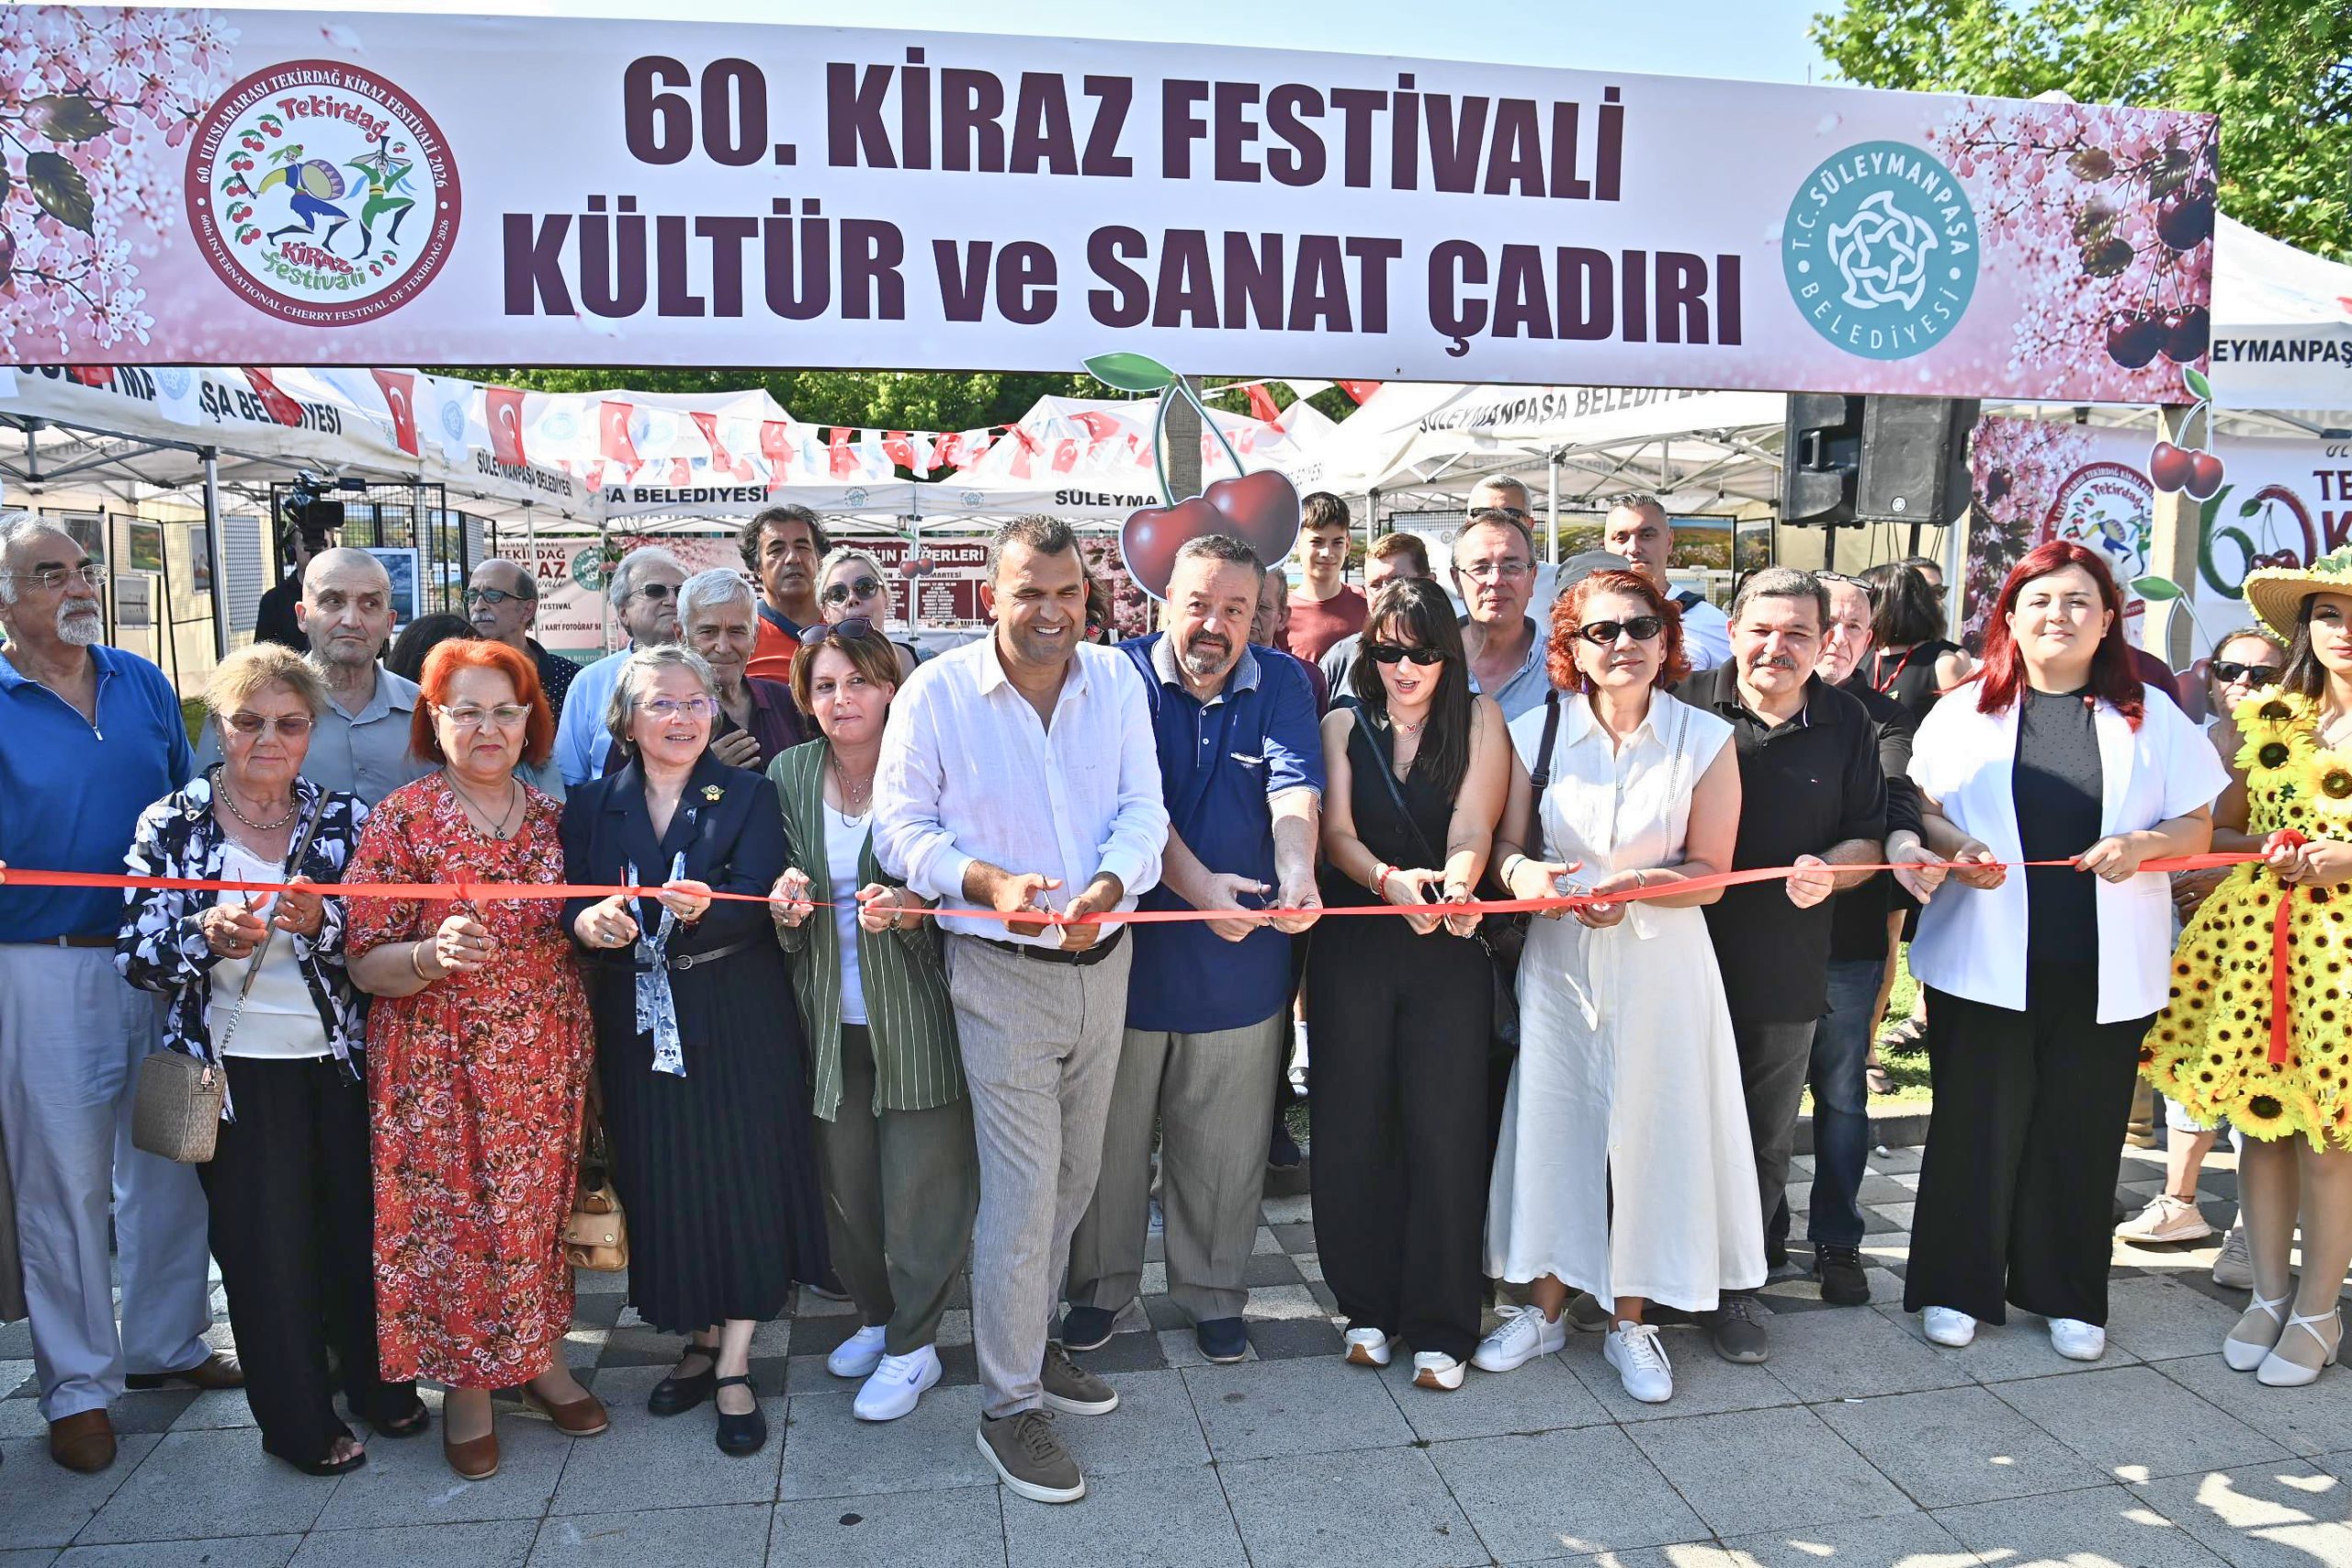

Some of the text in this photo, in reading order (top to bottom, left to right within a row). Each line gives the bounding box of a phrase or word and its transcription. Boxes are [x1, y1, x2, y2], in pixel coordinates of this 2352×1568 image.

[197, 67, 448, 188] 60. ULUSLARARASI TEKİRDAĞ KİRAZ FESTİVALİ 2026
[277, 95, 390, 143] Tekirdağ
[624, 47, 1624, 201] 60. KİRAZ FESTİVALİ
[1810, 152, 1971, 255] SÜLEYMANPAŞA
[199, 214, 450, 321] 60th INTERNATIONAL CHERRY FESTIVAL OF TEKİRDAĞ 2026
[503, 195, 1743, 357] KÜLTÜR ve SANAT ÇADIRI
[1801, 282, 1960, 349] BELEDİYESİ
[2210, 340, 2352, 368] EYMANPAŞ
[634, 485, 769, 502] BELEDİYESİ
[496, 547, 566, 559] TEKİDAĞ
[900, 546, 985, 562] DĞERLERİ
